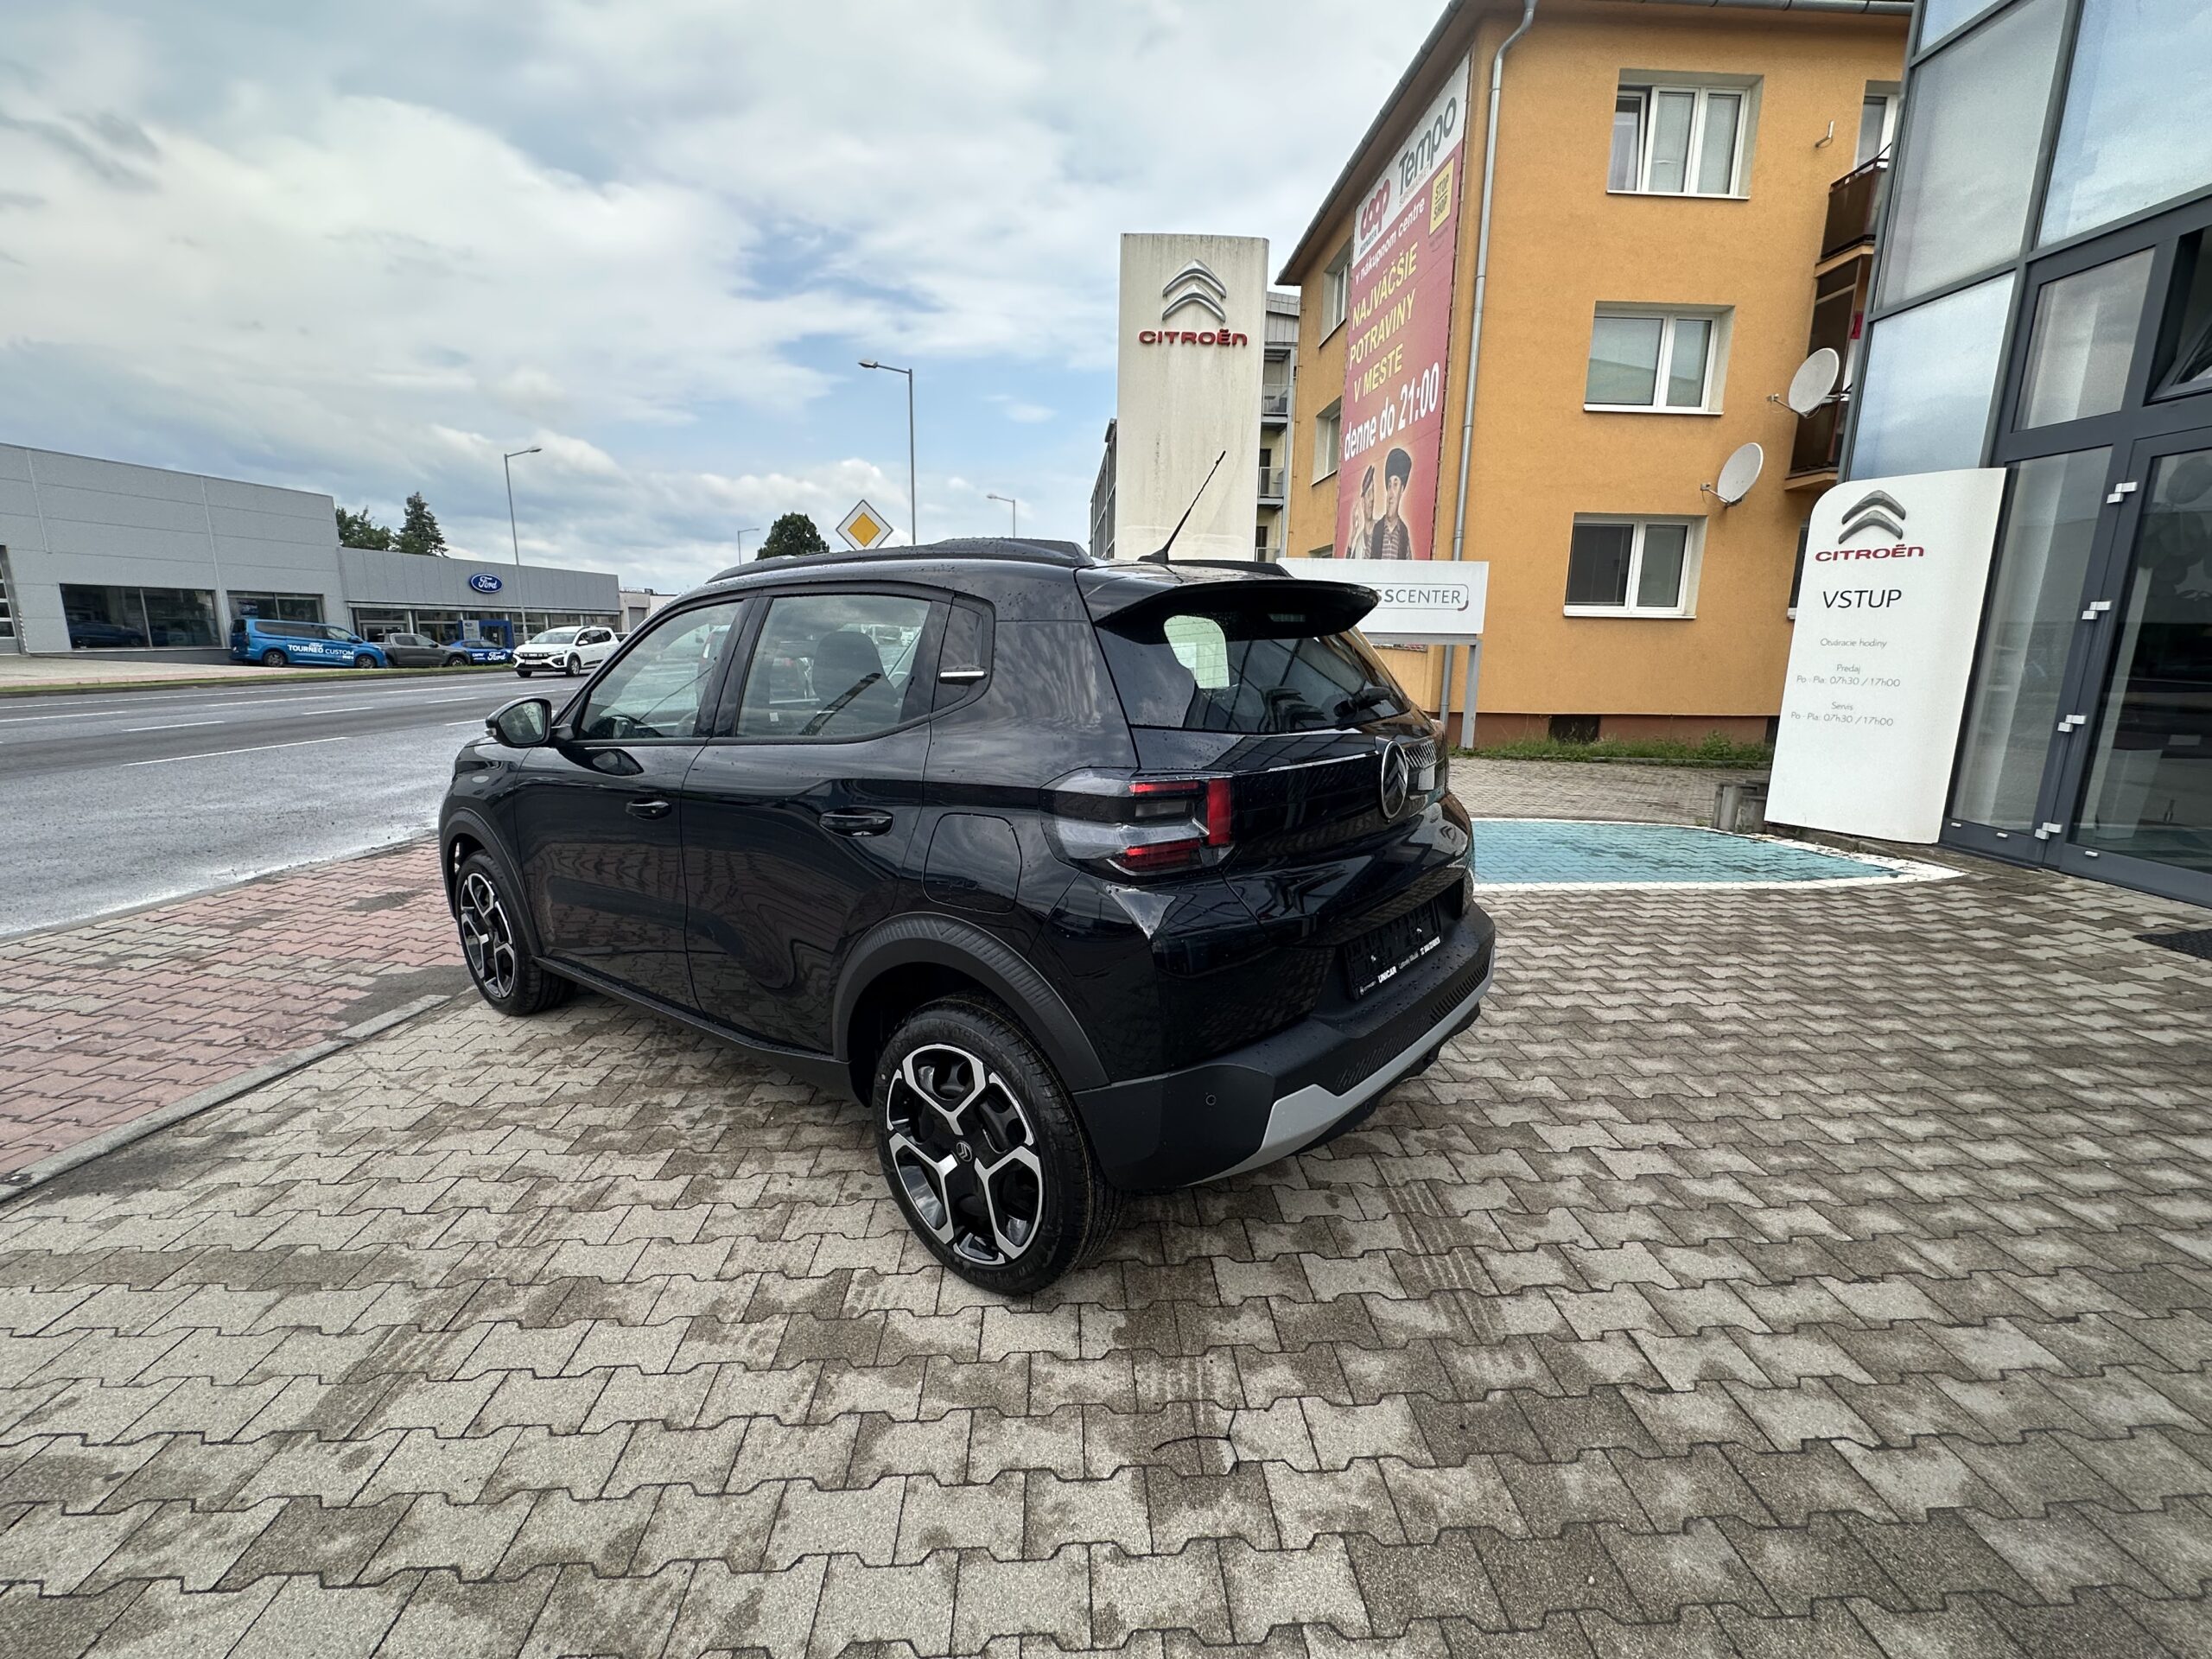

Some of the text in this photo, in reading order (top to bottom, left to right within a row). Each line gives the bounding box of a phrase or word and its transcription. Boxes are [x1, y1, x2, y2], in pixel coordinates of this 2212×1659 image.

[1398, 96, 1457, 197] Tempo
[1434, 174, 1450, 200] STOP
[1355, 197, 1426, 286] v nákupnom centre
[1351, 241, 1419, 331] NAJVÄČŠIE
[1350, 287, 1417, 371] POTRAVINY
[1353, 342, 1404, 404] V MESTE
[1344, 361, 1440, 462] denne do 21:00
[478, 575, 498, 589] Ford
[1822, 589, 1902, 608] VSTUP
[287, 644, 324, 653] TOURNEO
[1859, 638, 1888, 649] hodiny
[486, 652, 506, 661] Ford
[1836, 664, 1860, 674] Predaj
[1796, 675, 1807, 683] Po
[1829, 676, 1859, 685] 07h30
[1870, 677, 1901, 687] 17h00
[1831, 701, 1853, 711] Servis
[1790, 711, 1801, 720] Po
[1823, 713, 1853, 723] 07h30
[1864, 716, 1894, 727] 17h00
[1377, 965, 1397, 983] UNICAR
